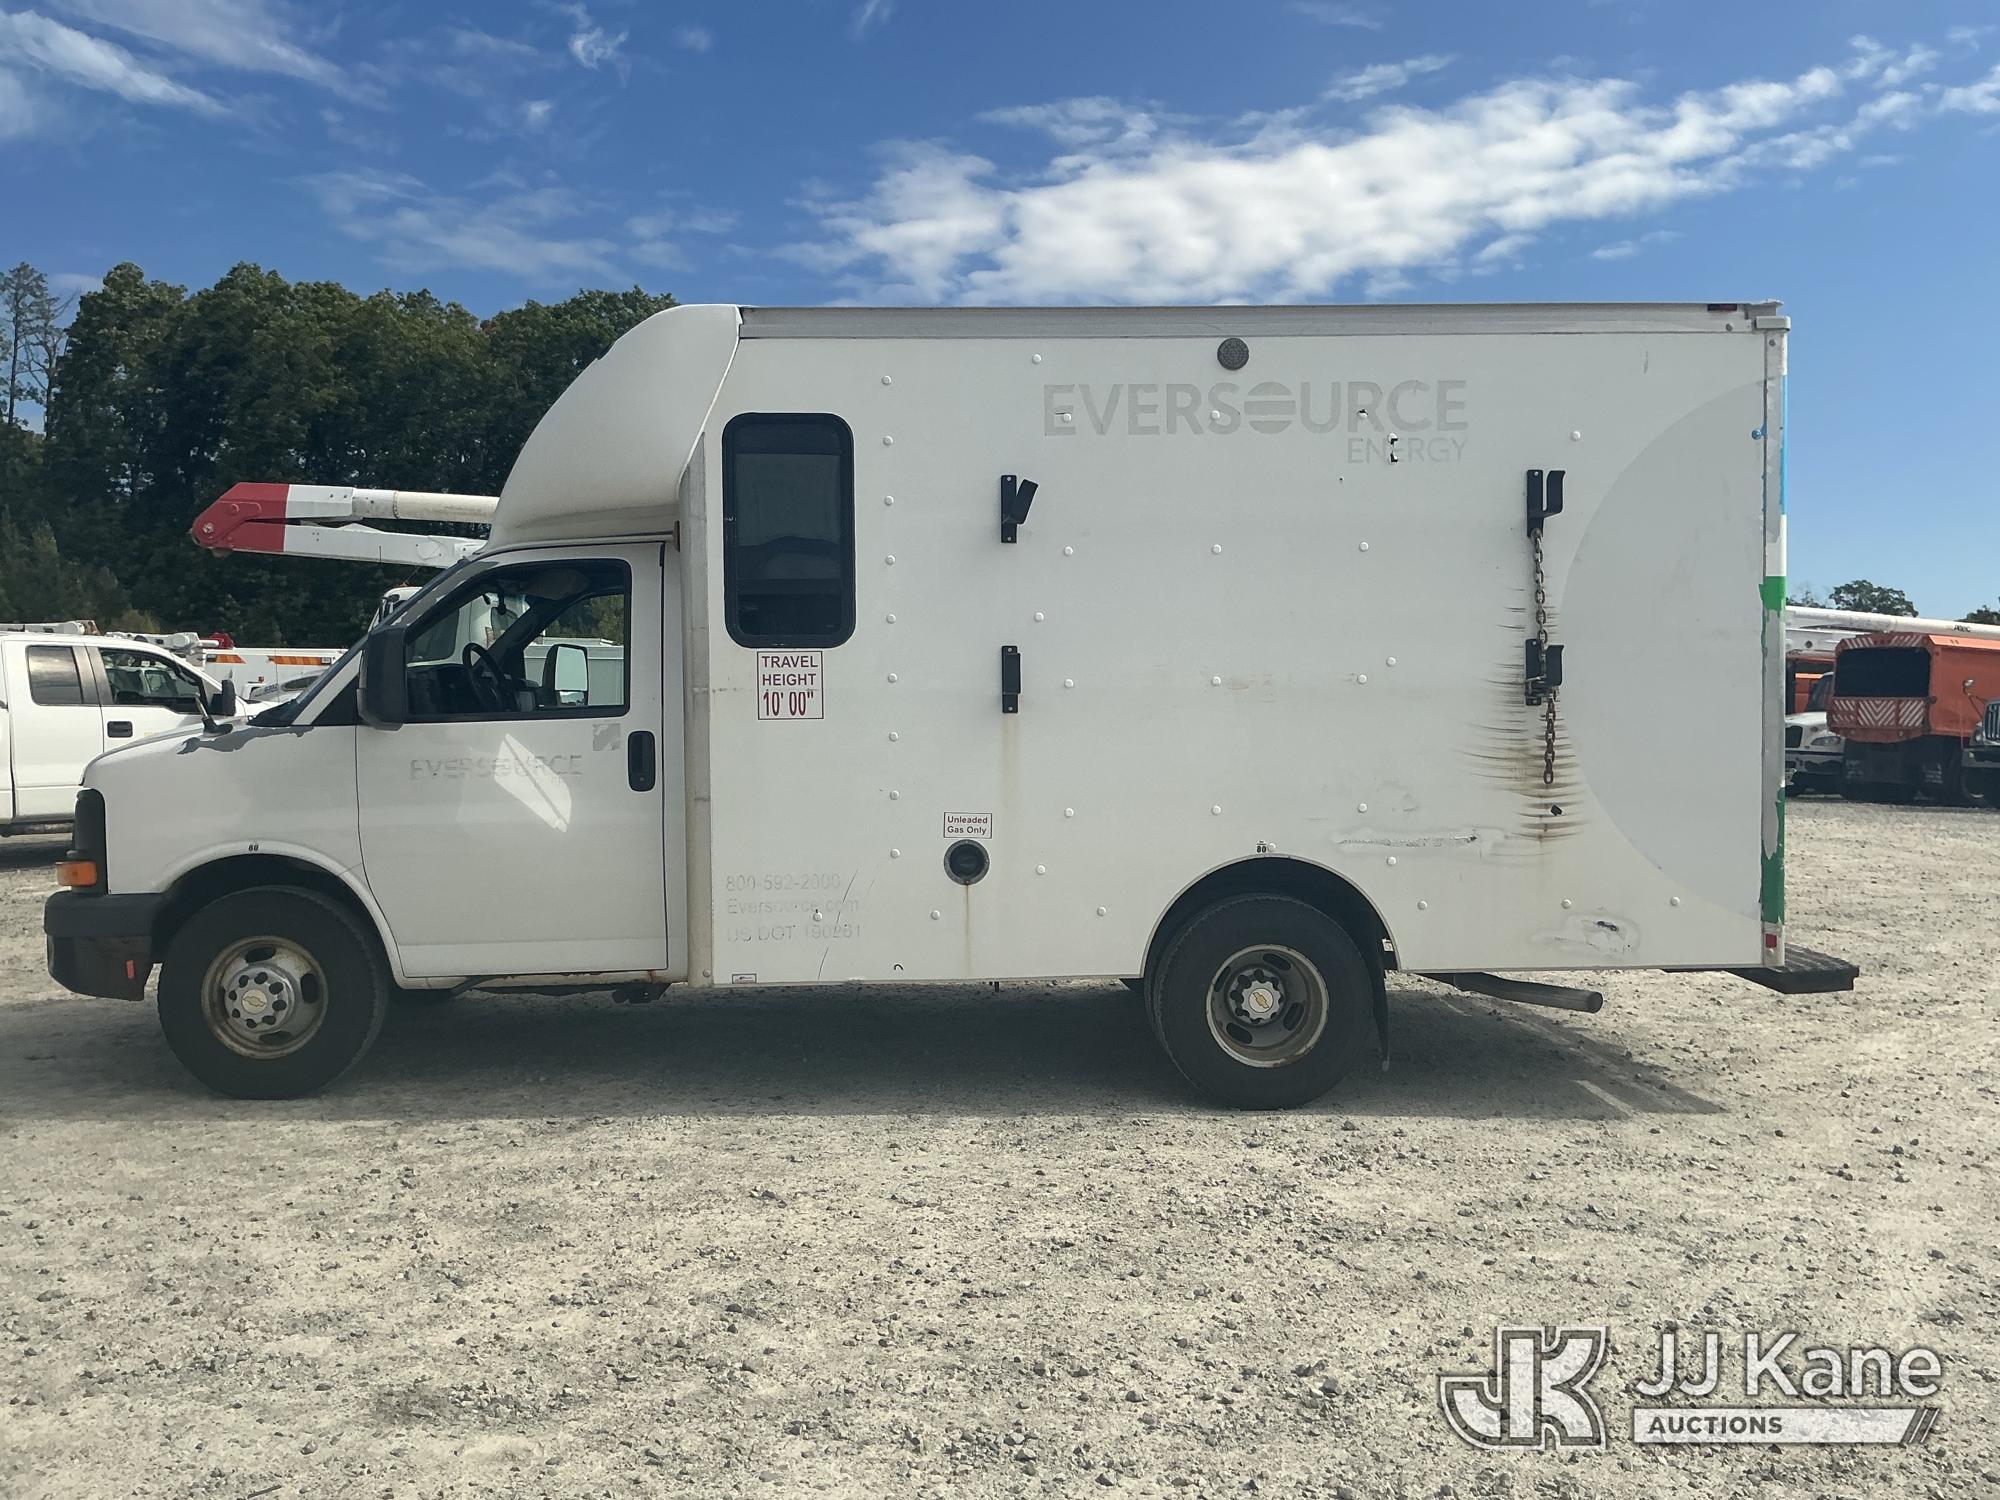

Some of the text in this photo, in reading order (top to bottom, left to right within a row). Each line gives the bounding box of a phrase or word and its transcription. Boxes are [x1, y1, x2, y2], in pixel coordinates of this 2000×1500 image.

[1043, 380, 1469, 436] EVERSOURCE
[1347, 437, 1469, 463] ENERGY
[761, 655, 818, 668] TRAVEL
[762, 673, 816, 686] HEIGHT
[763, 690, 814, 716] 10' 00"
[947, 815, 988, 824] Unleaded
[947, 825, 987, 836] Gas Only
[727, 899, 859, 914] Eversce.com
[758, 925, 793, 941] DOT
